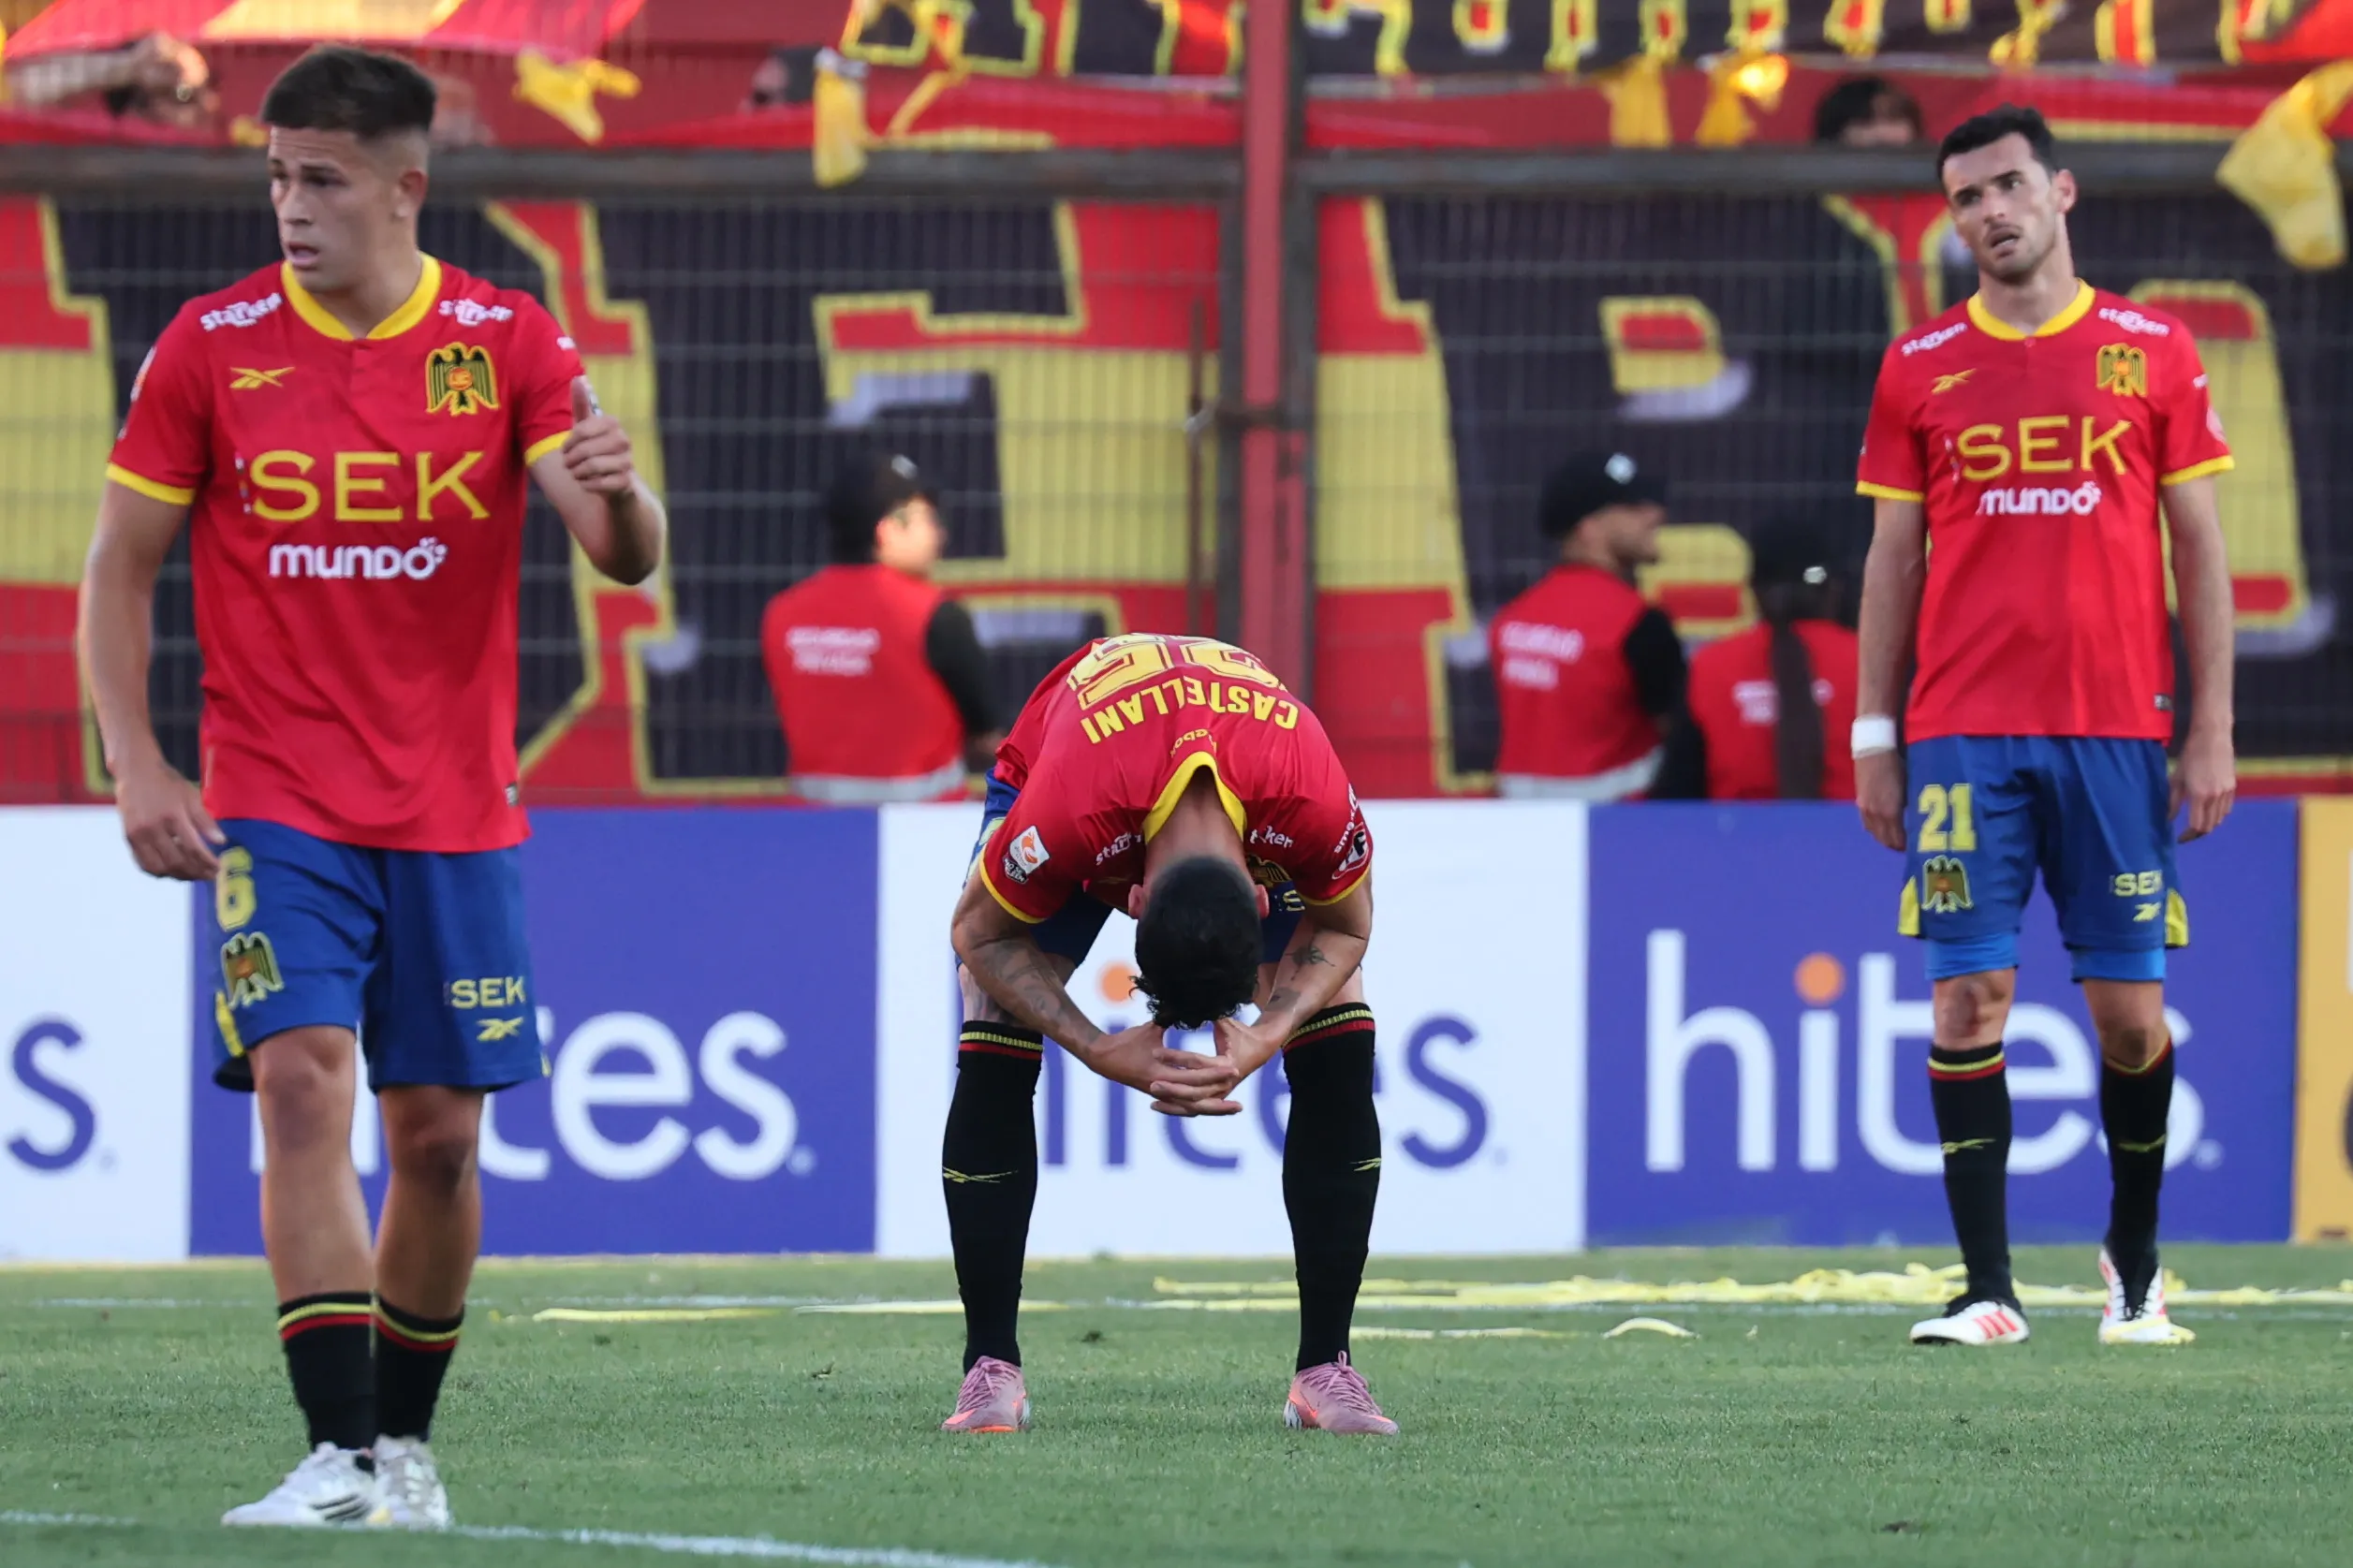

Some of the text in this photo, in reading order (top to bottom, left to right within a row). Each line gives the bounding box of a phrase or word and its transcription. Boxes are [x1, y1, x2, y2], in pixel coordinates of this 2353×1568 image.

[1957, 416, 2132, 481] SEK
[250, 450, 490, 521] SEK
[1080, 675, 1300, 744] CASTELLANI
[1918, 784, 1977, 853] 21
[216, 846, 257, 932] 6
[451, 976, 527, 1010] SEK
